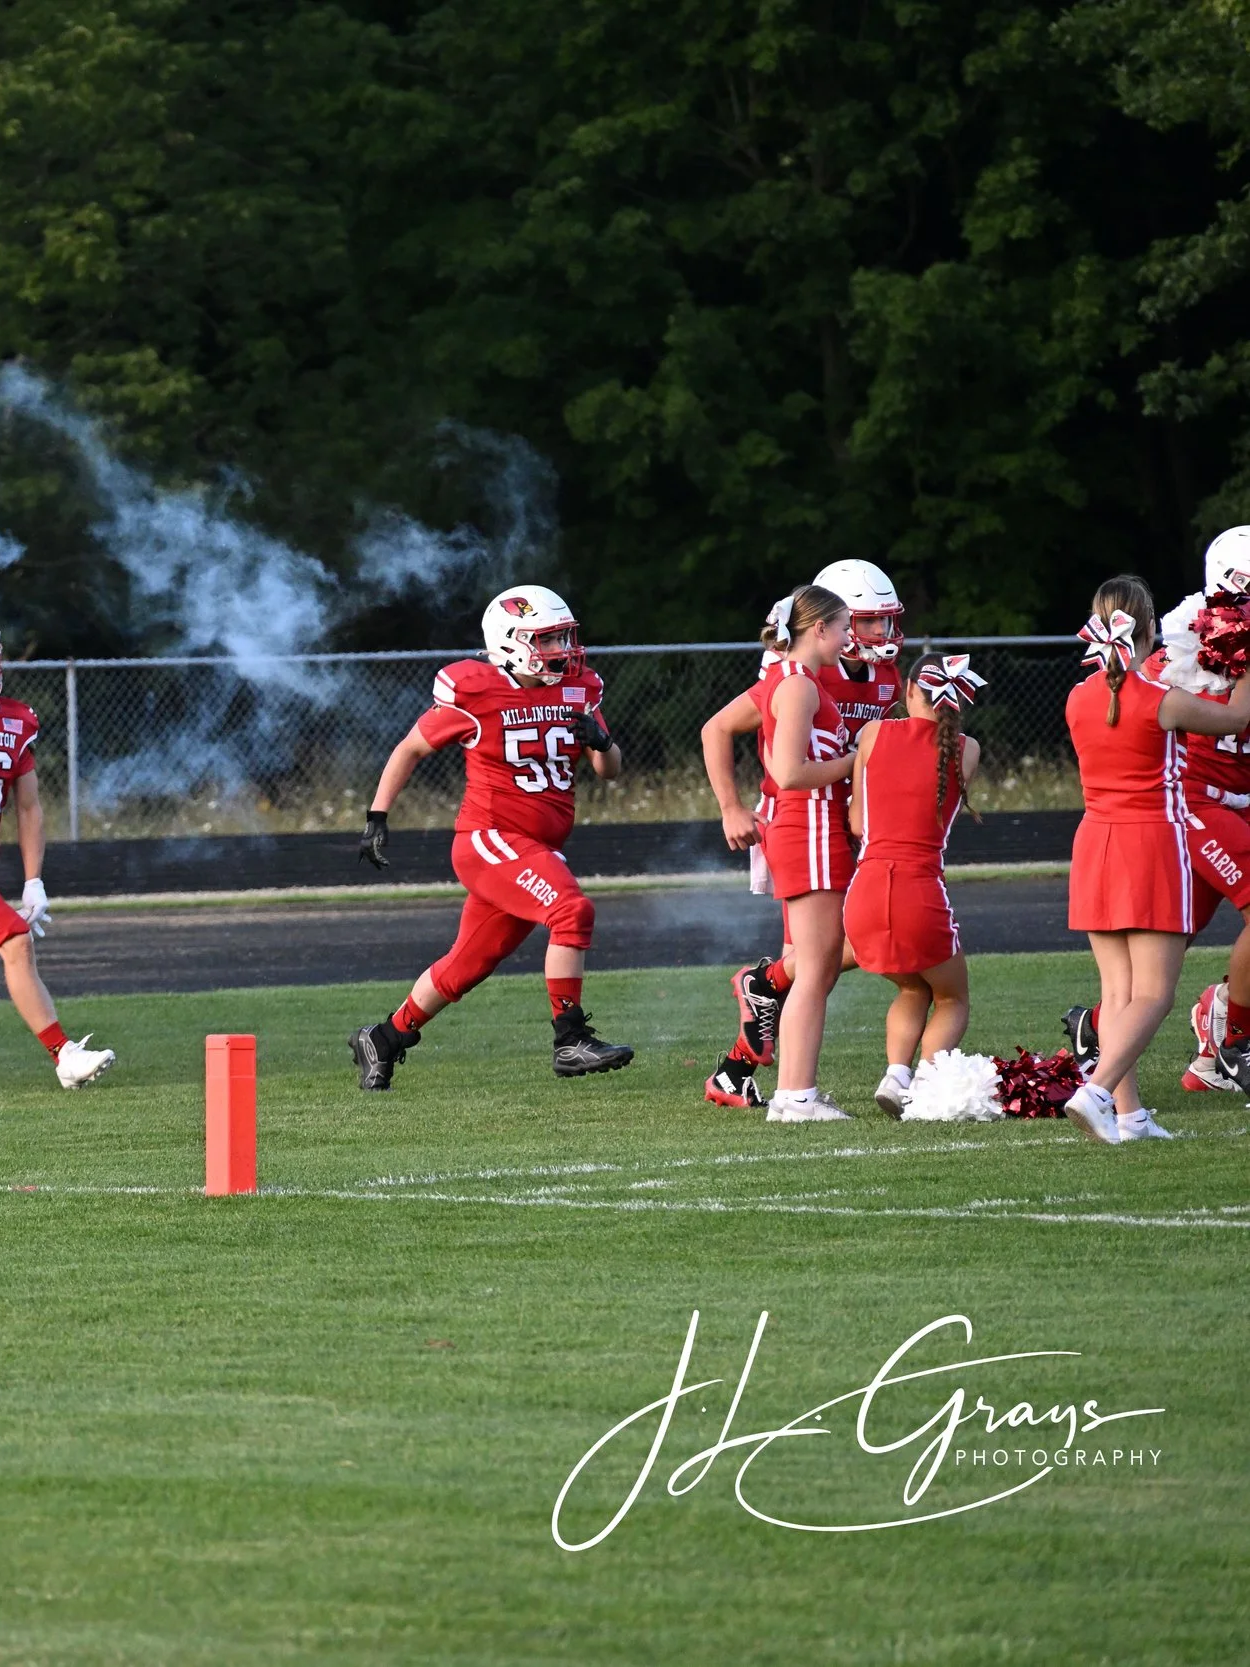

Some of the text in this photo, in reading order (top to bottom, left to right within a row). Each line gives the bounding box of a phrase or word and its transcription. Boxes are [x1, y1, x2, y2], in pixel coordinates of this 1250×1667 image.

[504, 726, 575, 793] 56
[1200, 839, 1243, 886] CARDS
[516, 868, 558, 907] CARDS
